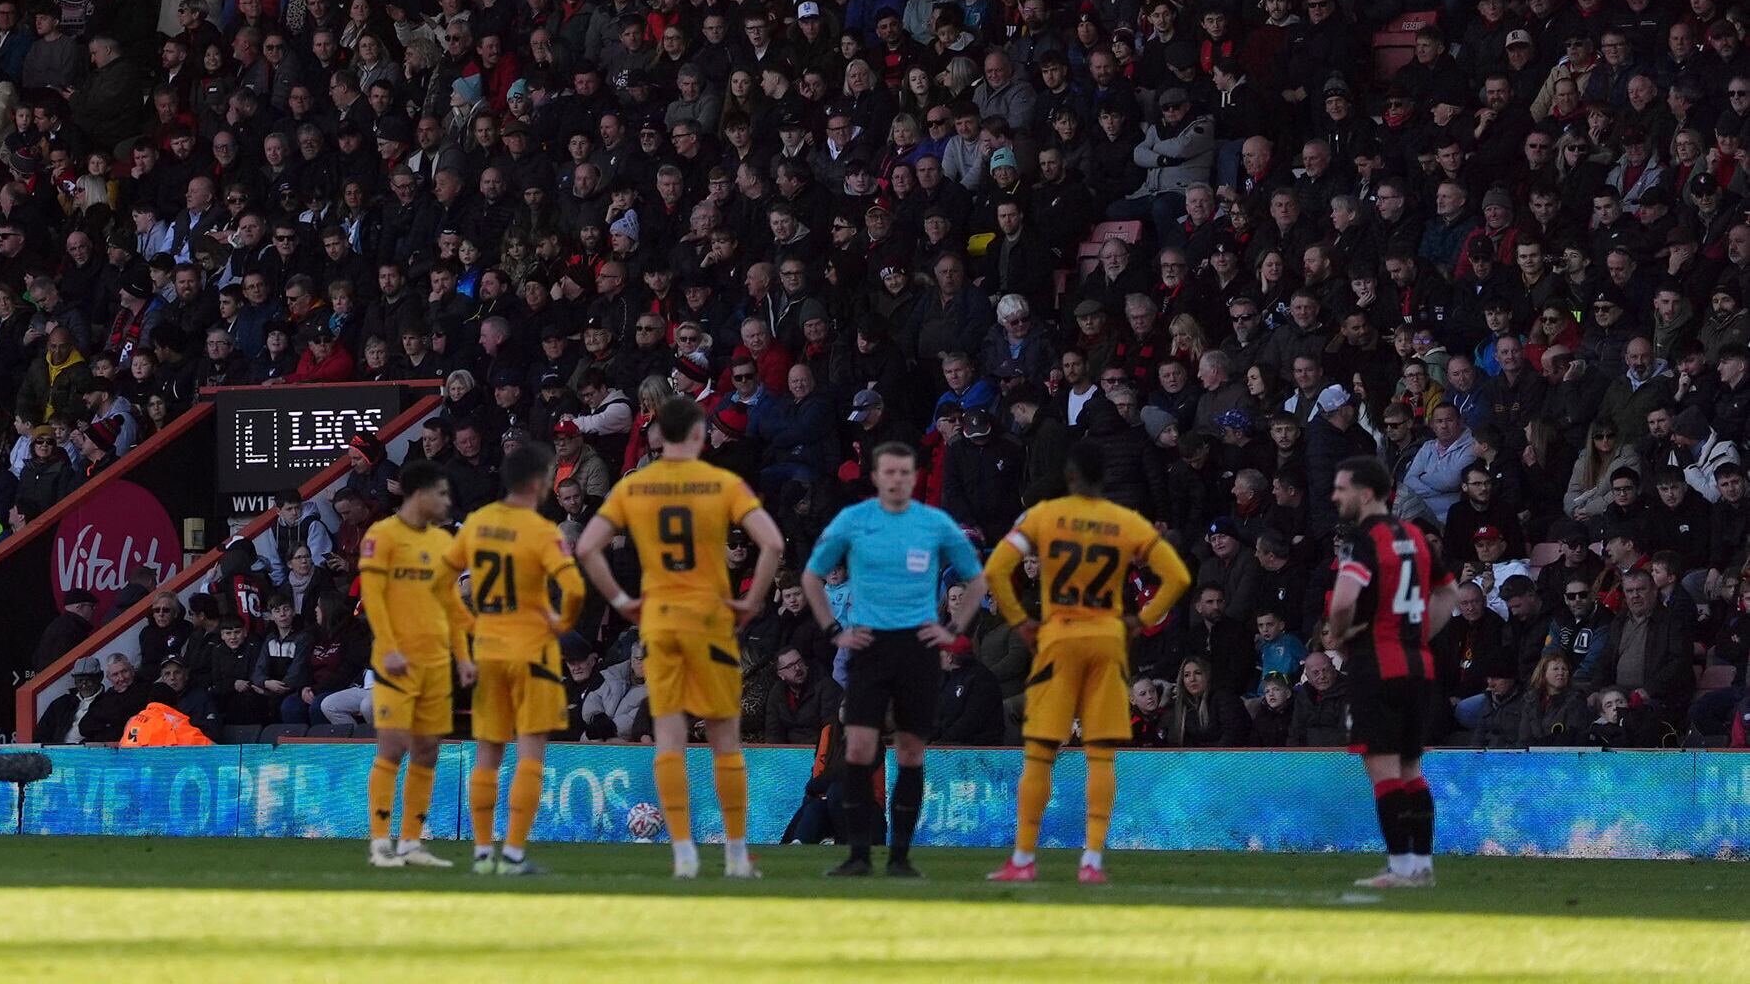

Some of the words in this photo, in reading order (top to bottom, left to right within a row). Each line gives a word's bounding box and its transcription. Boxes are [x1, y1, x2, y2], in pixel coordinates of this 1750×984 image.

[58, 524, 177, 592] Vitalty
[659, 506, 695, 571] 9
[474, 549, 517, 613] 21
[1049, 540, 1119, 608] 22
[1392, 559, 1426, 624] 4
